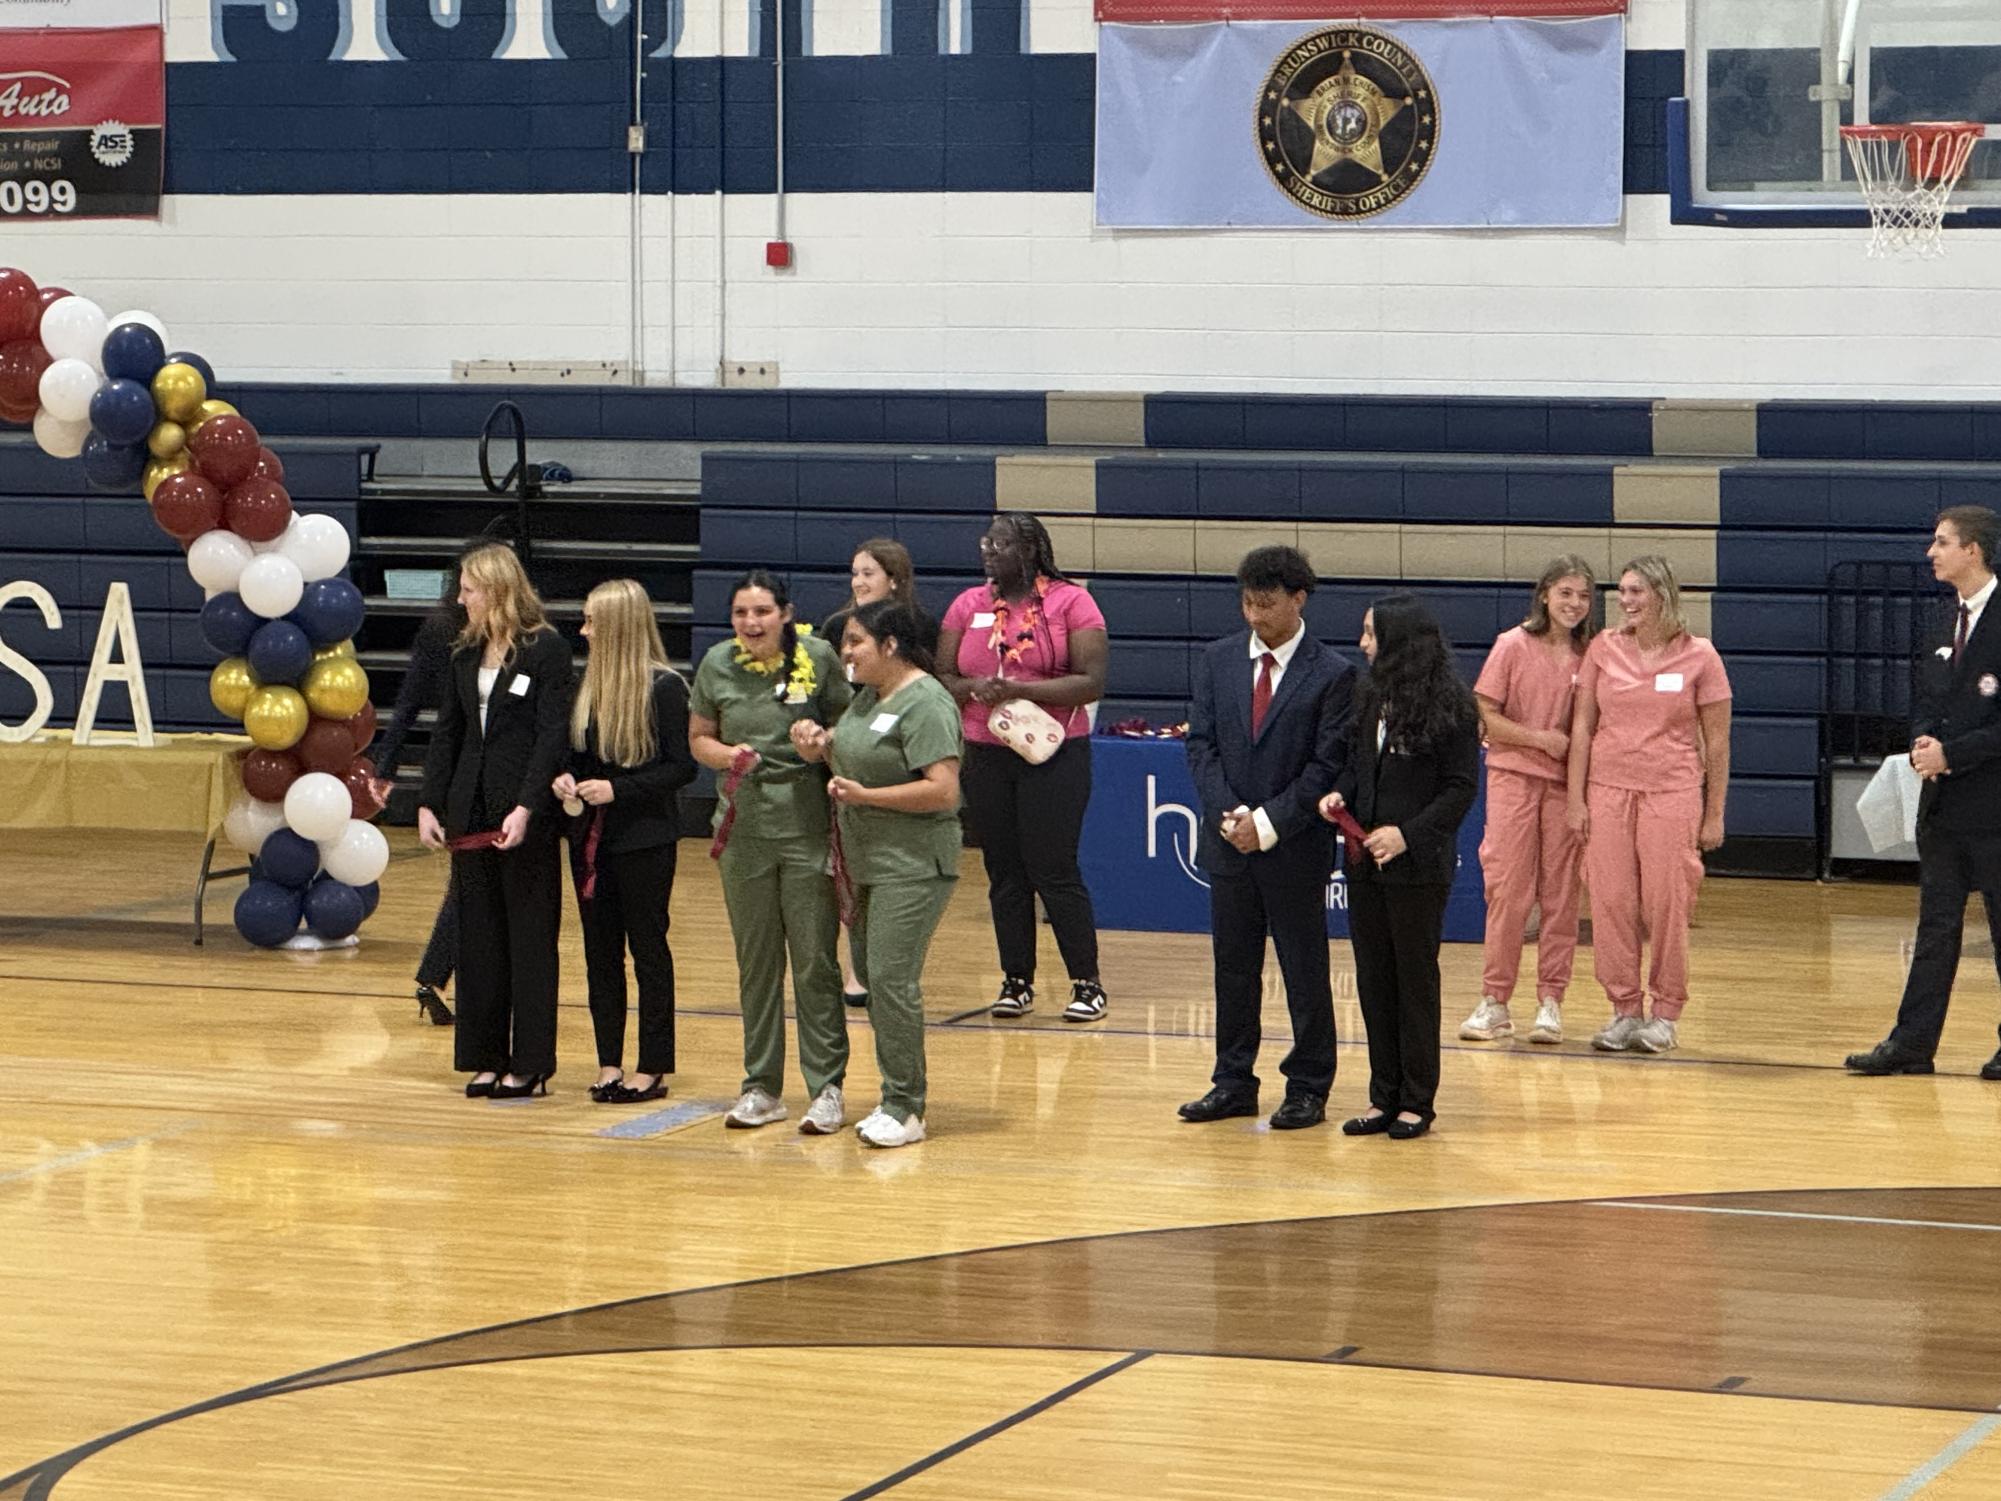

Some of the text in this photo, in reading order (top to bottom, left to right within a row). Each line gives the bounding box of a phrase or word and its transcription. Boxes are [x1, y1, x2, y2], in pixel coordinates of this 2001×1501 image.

[1275, 32, 1420, 86] BRUNSWICK COUNTY
[0, 82, 70, 117] Auto
[23, 139, 60, 154] Repair
[96, 133, 128, 150] ASE
[0, 179, 77, 213] 099
[1359, 176, 1410, 211] OFFICE
[0, 580, 155, 747] SA
